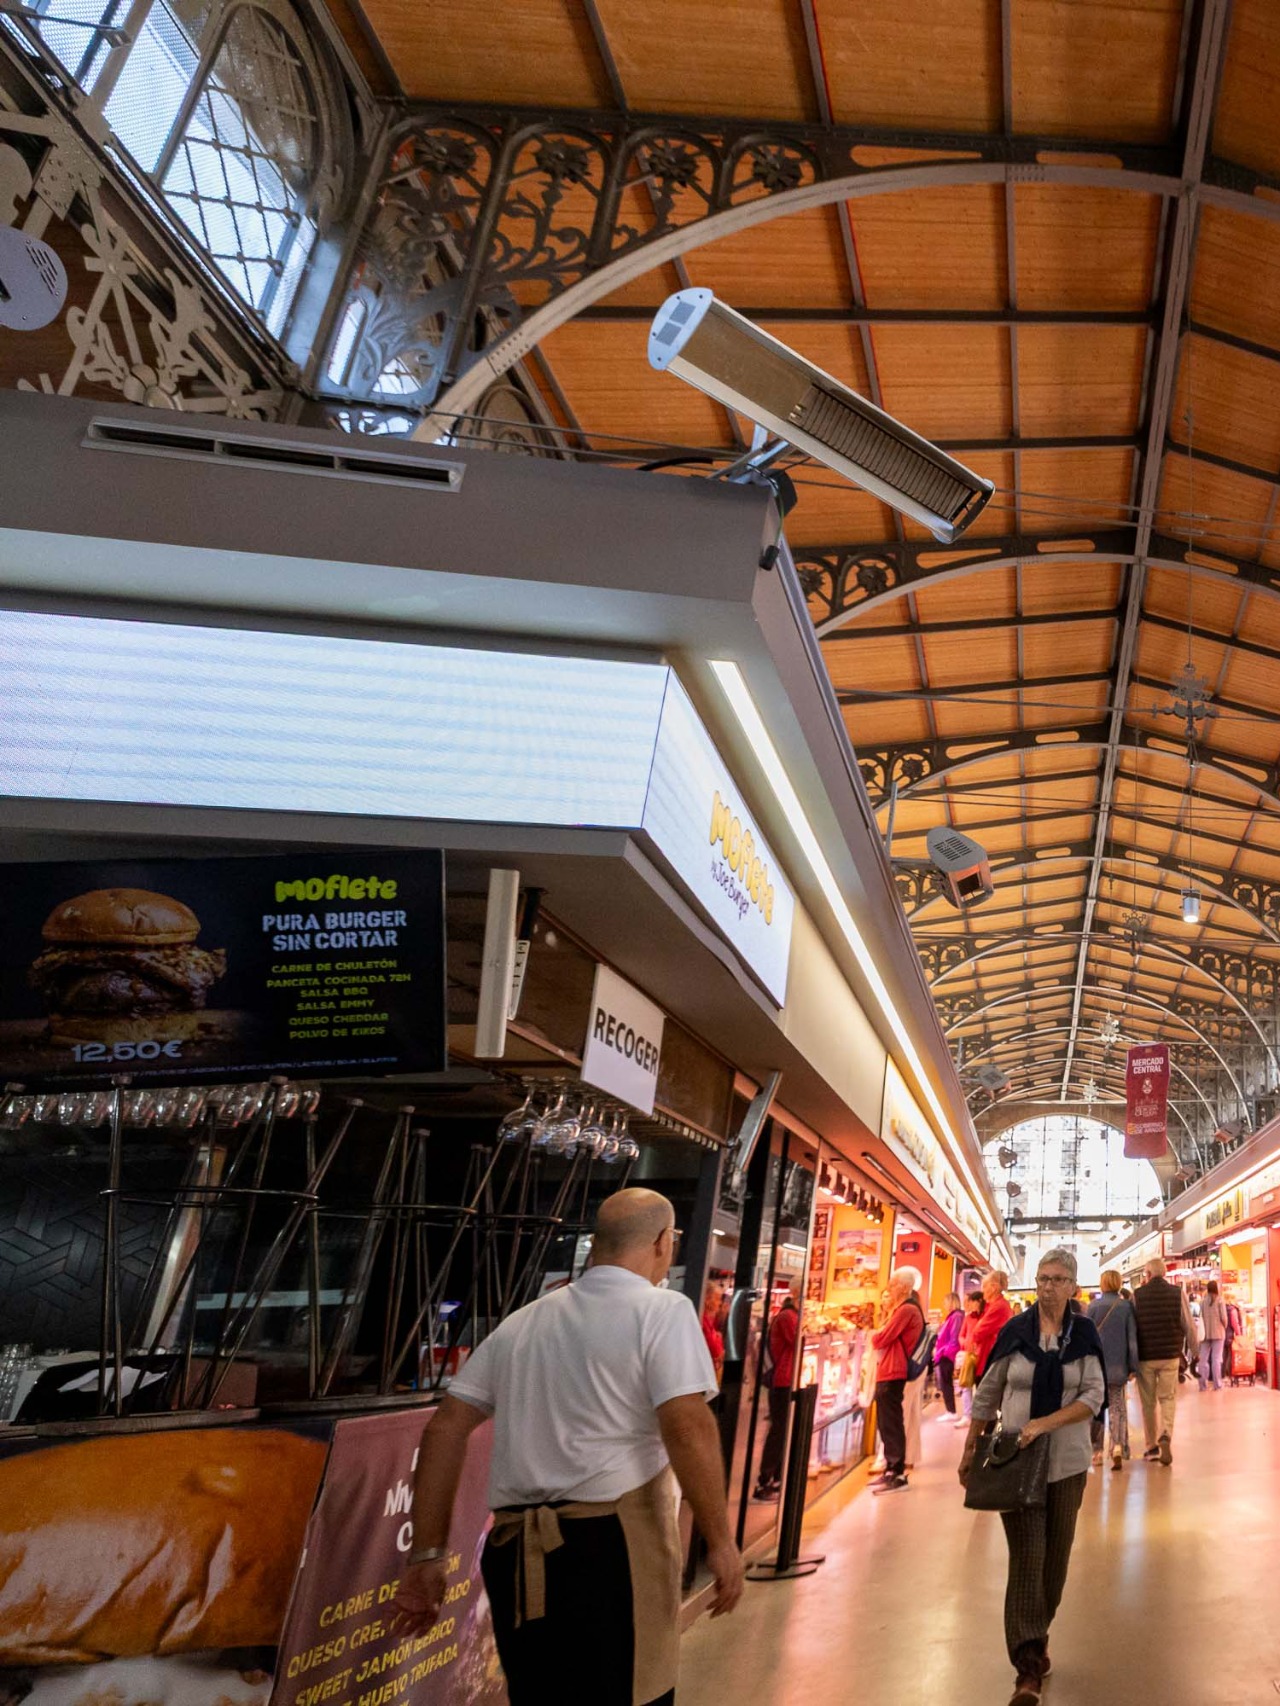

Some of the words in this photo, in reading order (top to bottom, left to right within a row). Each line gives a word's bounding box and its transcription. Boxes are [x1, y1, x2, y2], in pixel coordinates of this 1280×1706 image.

[262, 914, 320, 932] PURA
[324, 910, 407, 930] BURGER
[273, 933, 311, 951] SIN
[314, 930, 398, 949] CORTAR
[271, 963, 312, 974] CARNE
[316, 962, 332, 972] DE
[335, 958, 397, 971] CHULETÓN
[266, 977, 321, 988] PANCETA
[324, 974, 386, 986] COCINADA
[300, 988, 339, 998] SALSA
[296, 1001, 336, 1011] SALSA
[288, 1015, 329, 1026] QUESO
[333, 1012, 389, 1023] CHEDDAR
[289, 1029, 329, 1039] POLVO
[332, 1028, 348, 1037] DE
[594, 1007, 659, 1076] RECOGER
[71, 1039, 183, 1064] 12,50€
[1132, 1057, 1164, 1067] MERCADO
[1133, 1065, 1162, 1075] CENTRAL
[319, 1587, 375, 1628] CARNE
[287, 1636, 347, 1679] QUESO
[355, 1637, 413, 1682] JAMÓN
[358, 1672, 409, 1706] HUEVO
[410, 1642, 458, 1686] TRUFADA
